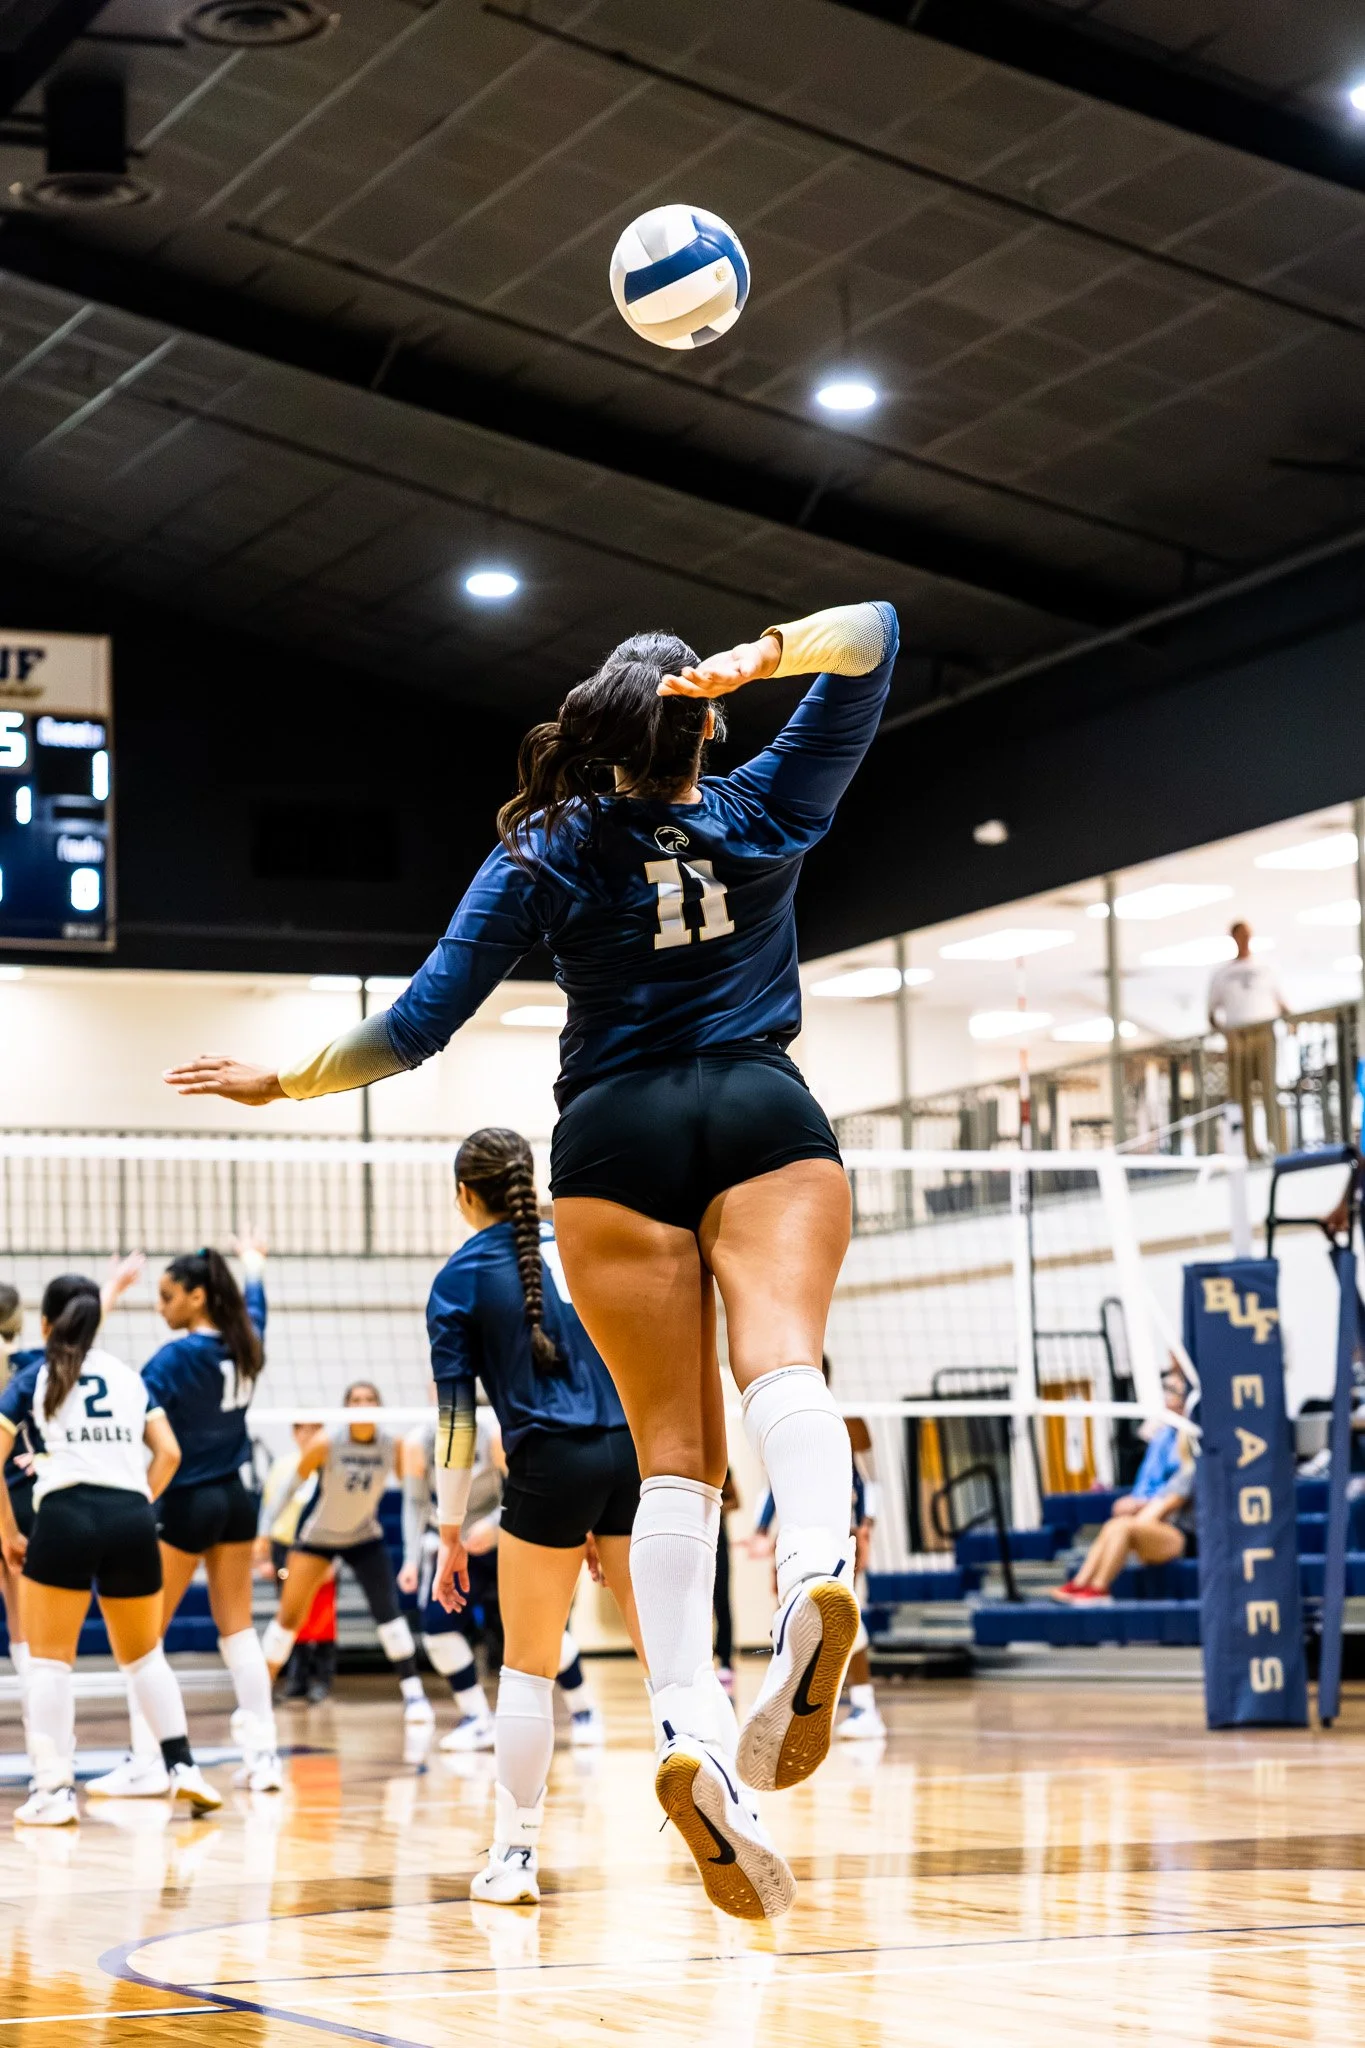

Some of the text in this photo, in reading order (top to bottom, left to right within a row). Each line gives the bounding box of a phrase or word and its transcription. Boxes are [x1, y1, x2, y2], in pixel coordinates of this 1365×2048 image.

[644, 857, 735, 950] 11
[78, 1376, 113, 1418] 2
[66, 1425, 133, 1443] EAGLES
[1231, 1373, 1284, 1694] EAGLES
